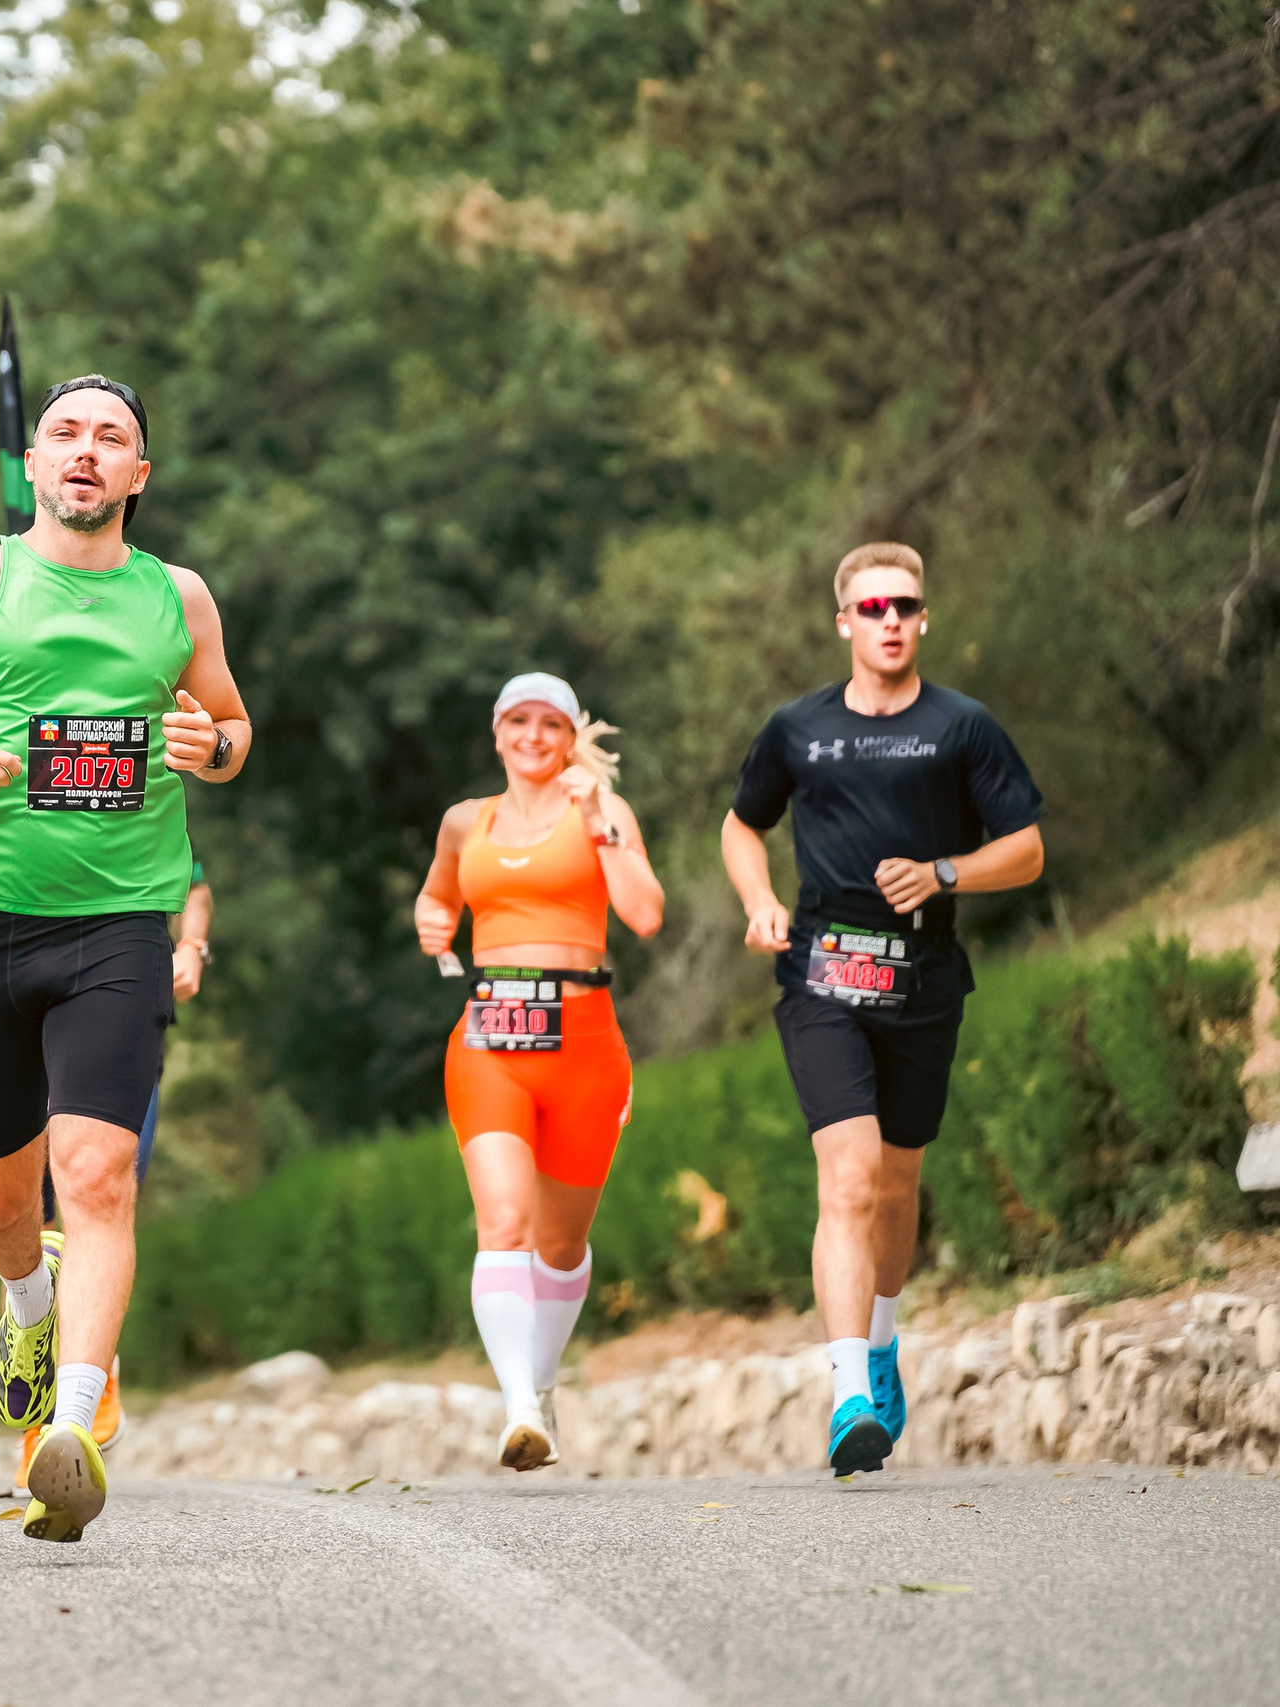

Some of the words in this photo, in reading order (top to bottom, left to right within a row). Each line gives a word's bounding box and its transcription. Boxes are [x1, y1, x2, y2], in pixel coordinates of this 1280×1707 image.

[67, 719, 125, 732] ПЯТИГОРСКИЙ
[66, 731, 125, 742] ПОЛУМАРАФОН
[854, 735, 920, 749] UNDER
[854, 743, 937, 760] ARMOUR
[51, 756, 135, 788] 2079
[65, 789, 122, 798] ПОЛУМАРАФОН
[823, 960, 895, 991] 2089
[480, 1007, 548, 1034] 2110
